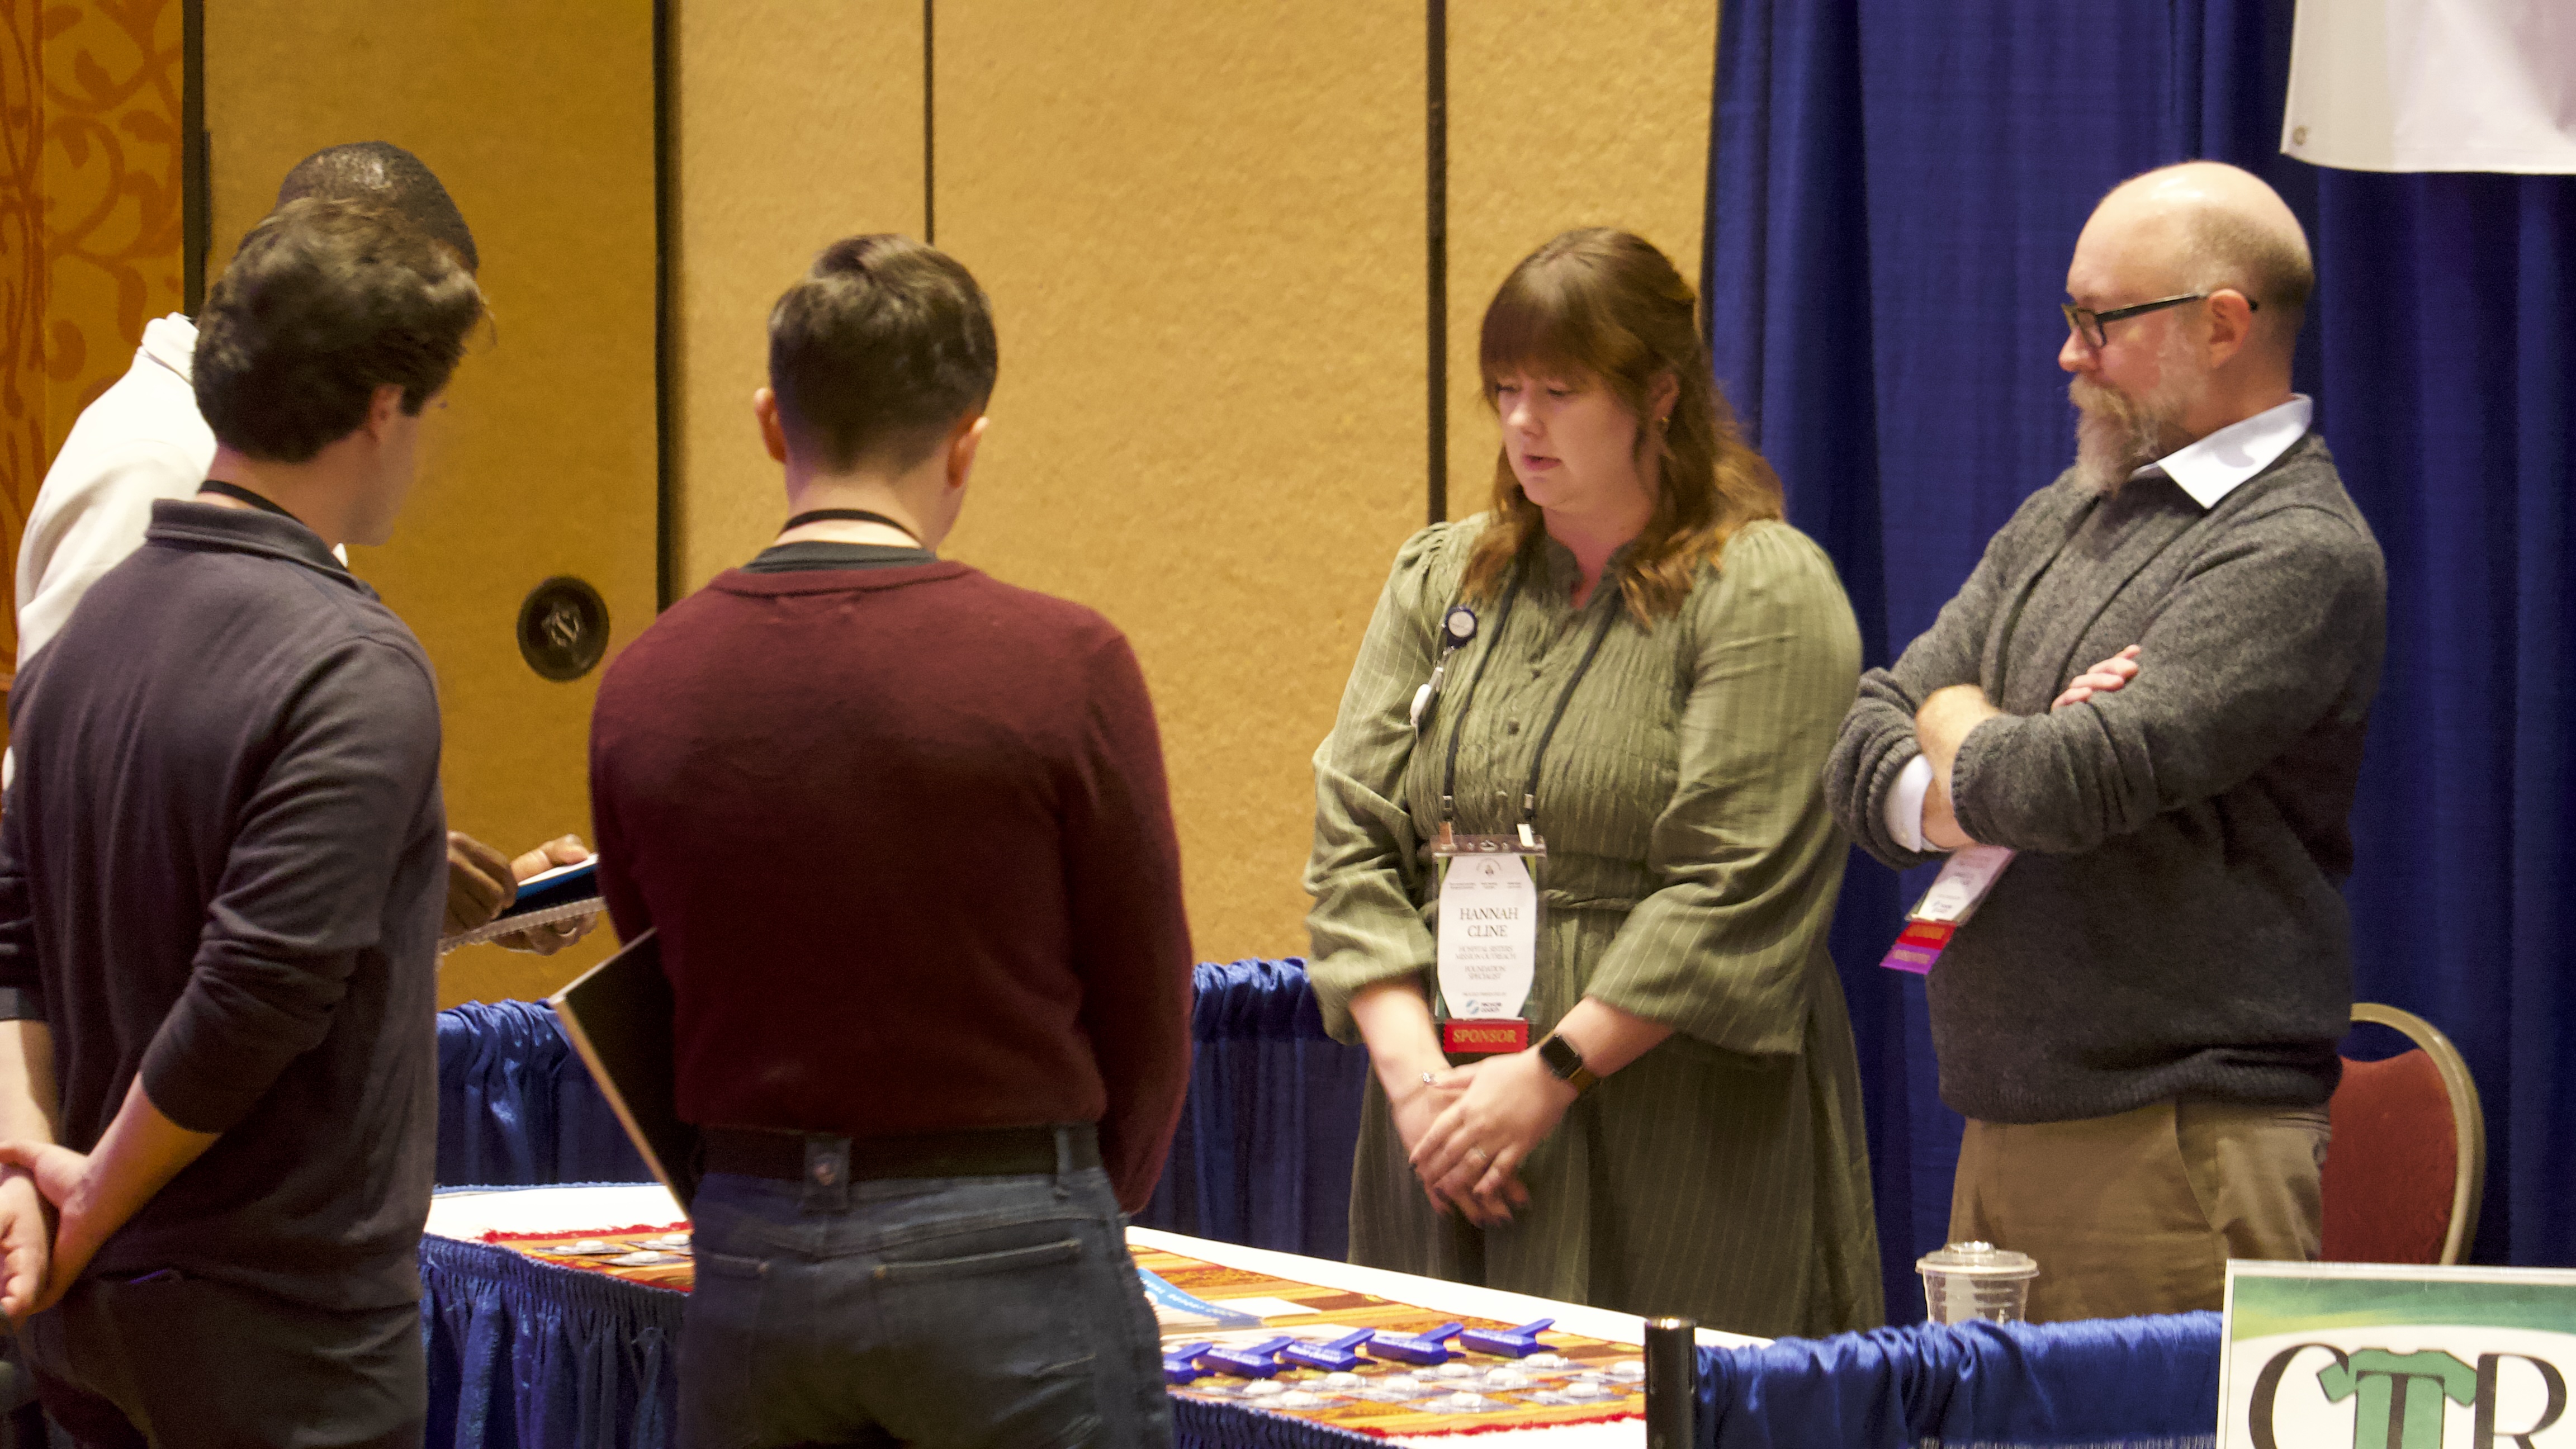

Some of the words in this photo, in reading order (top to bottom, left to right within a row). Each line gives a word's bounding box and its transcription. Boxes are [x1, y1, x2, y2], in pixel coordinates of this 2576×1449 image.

[1459, 907, 1518, 920] HANNAH
[1467, 925, 1508, 937] CLINE
[1453, 1029, 1517, 1043] SPONSOR
